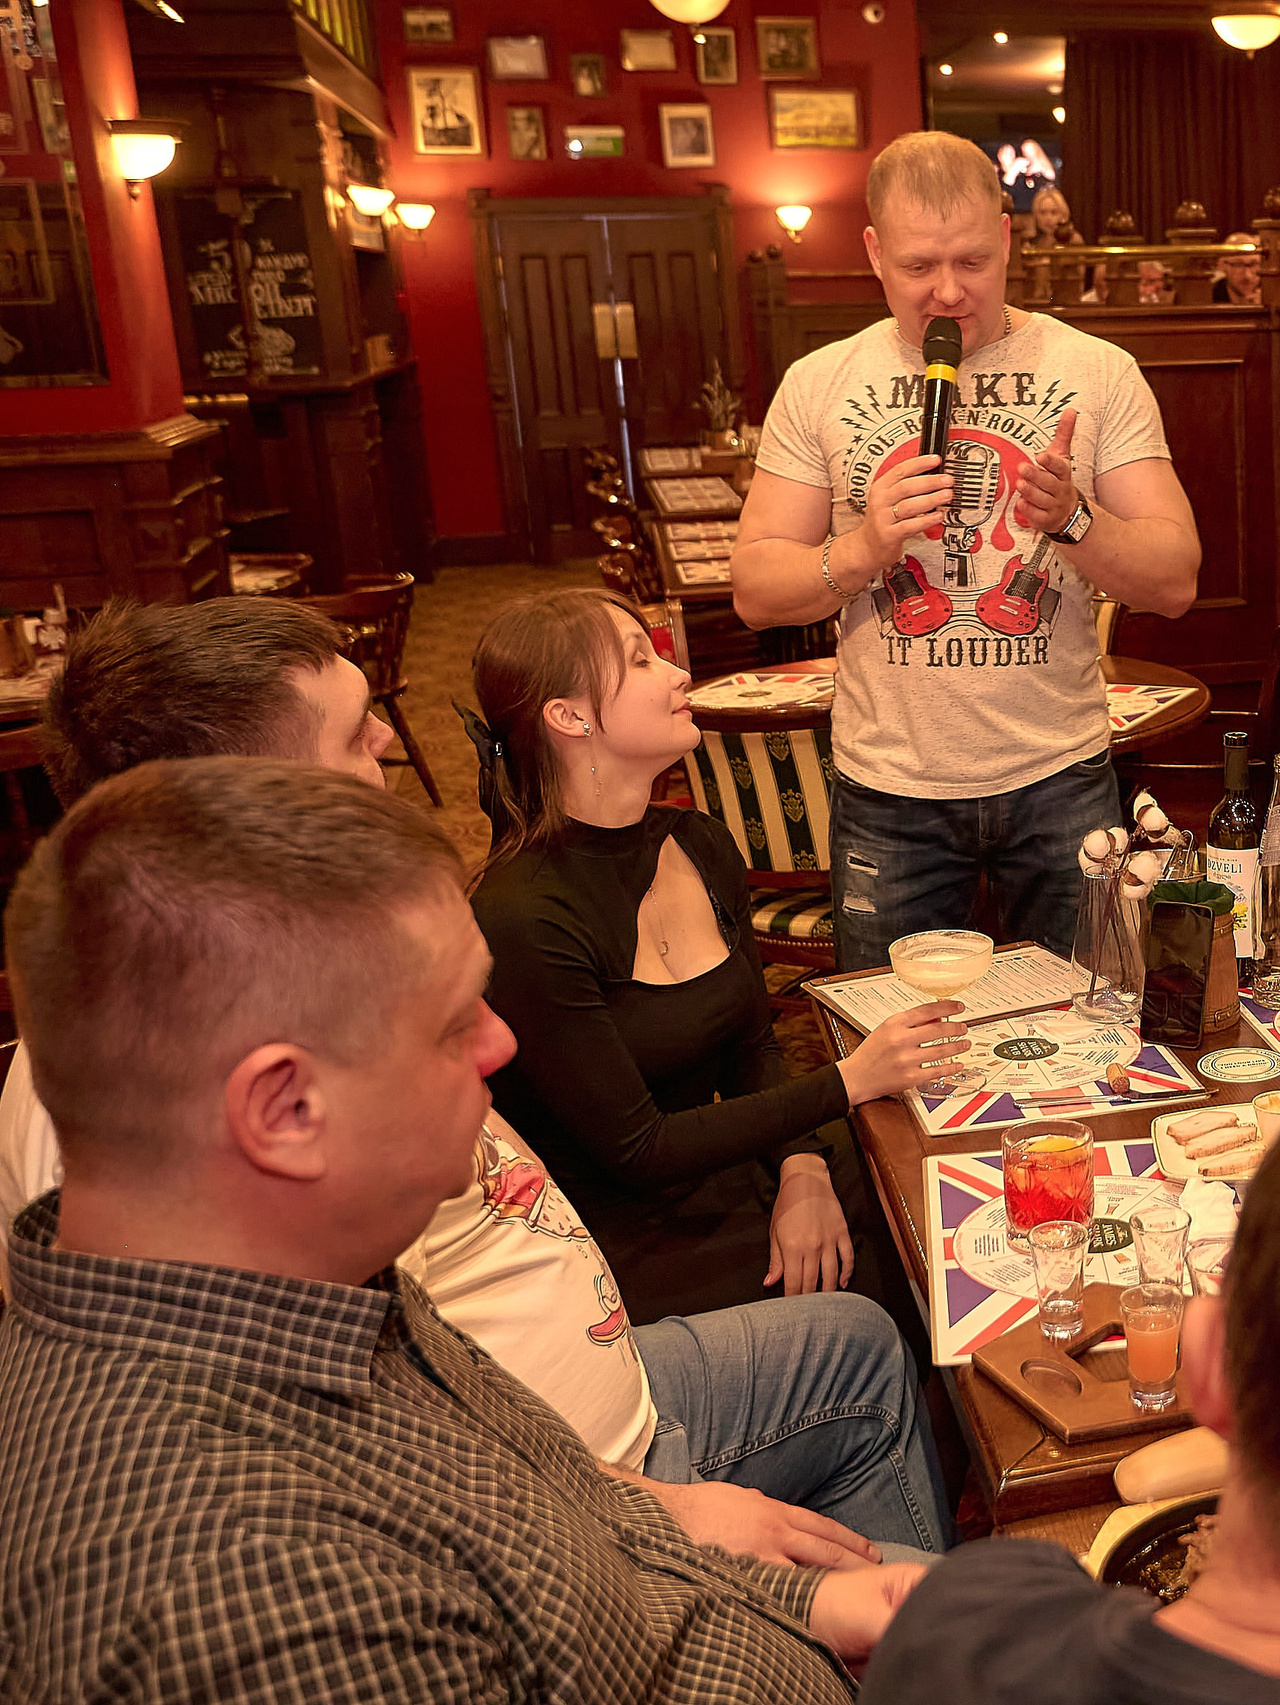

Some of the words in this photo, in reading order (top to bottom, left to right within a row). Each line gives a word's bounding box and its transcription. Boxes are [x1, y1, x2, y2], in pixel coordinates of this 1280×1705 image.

[986, 412, 1037, 447] ROLL
[886, 636, 912, 666] IT
[925, 636, 1050, 668] LOUDER
